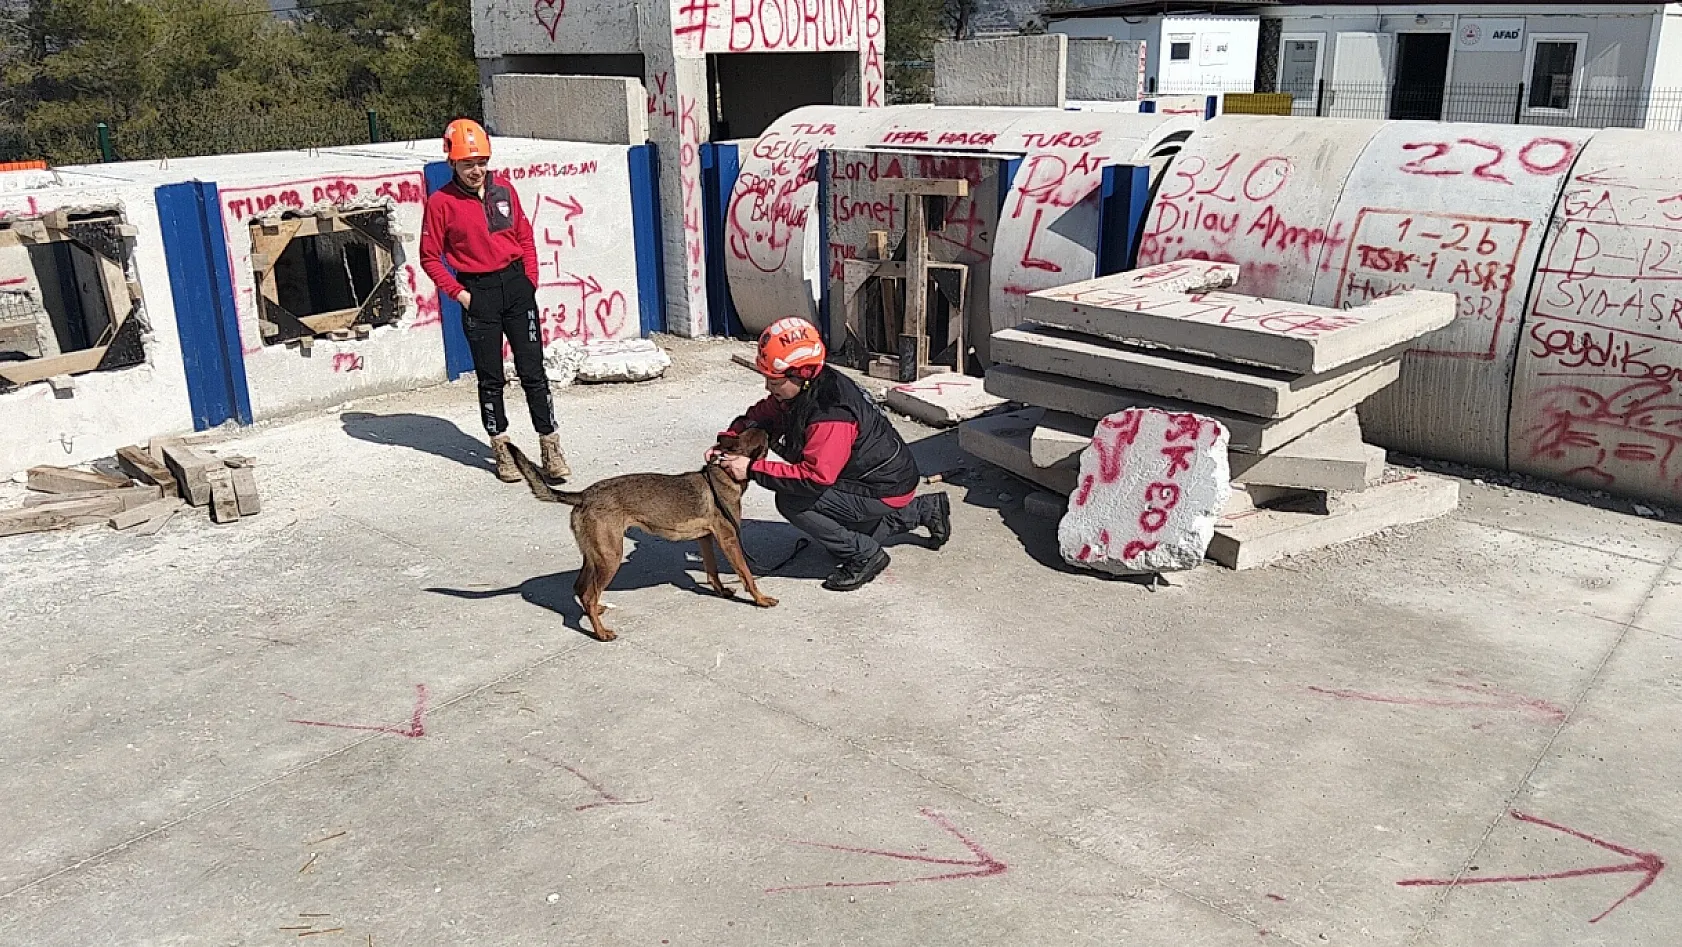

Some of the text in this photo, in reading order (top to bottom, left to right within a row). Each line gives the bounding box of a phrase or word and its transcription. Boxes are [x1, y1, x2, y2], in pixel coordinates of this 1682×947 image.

[1492, 29, 1520, 40] AFAD
[831, 152, 878, 182] Lord
[1161, 152, 1293, 202] 310
[1399, 137, 1576, 185] 220
[526, 308, 538, 342] NAK
[778, 327, 809, 348] NAK
